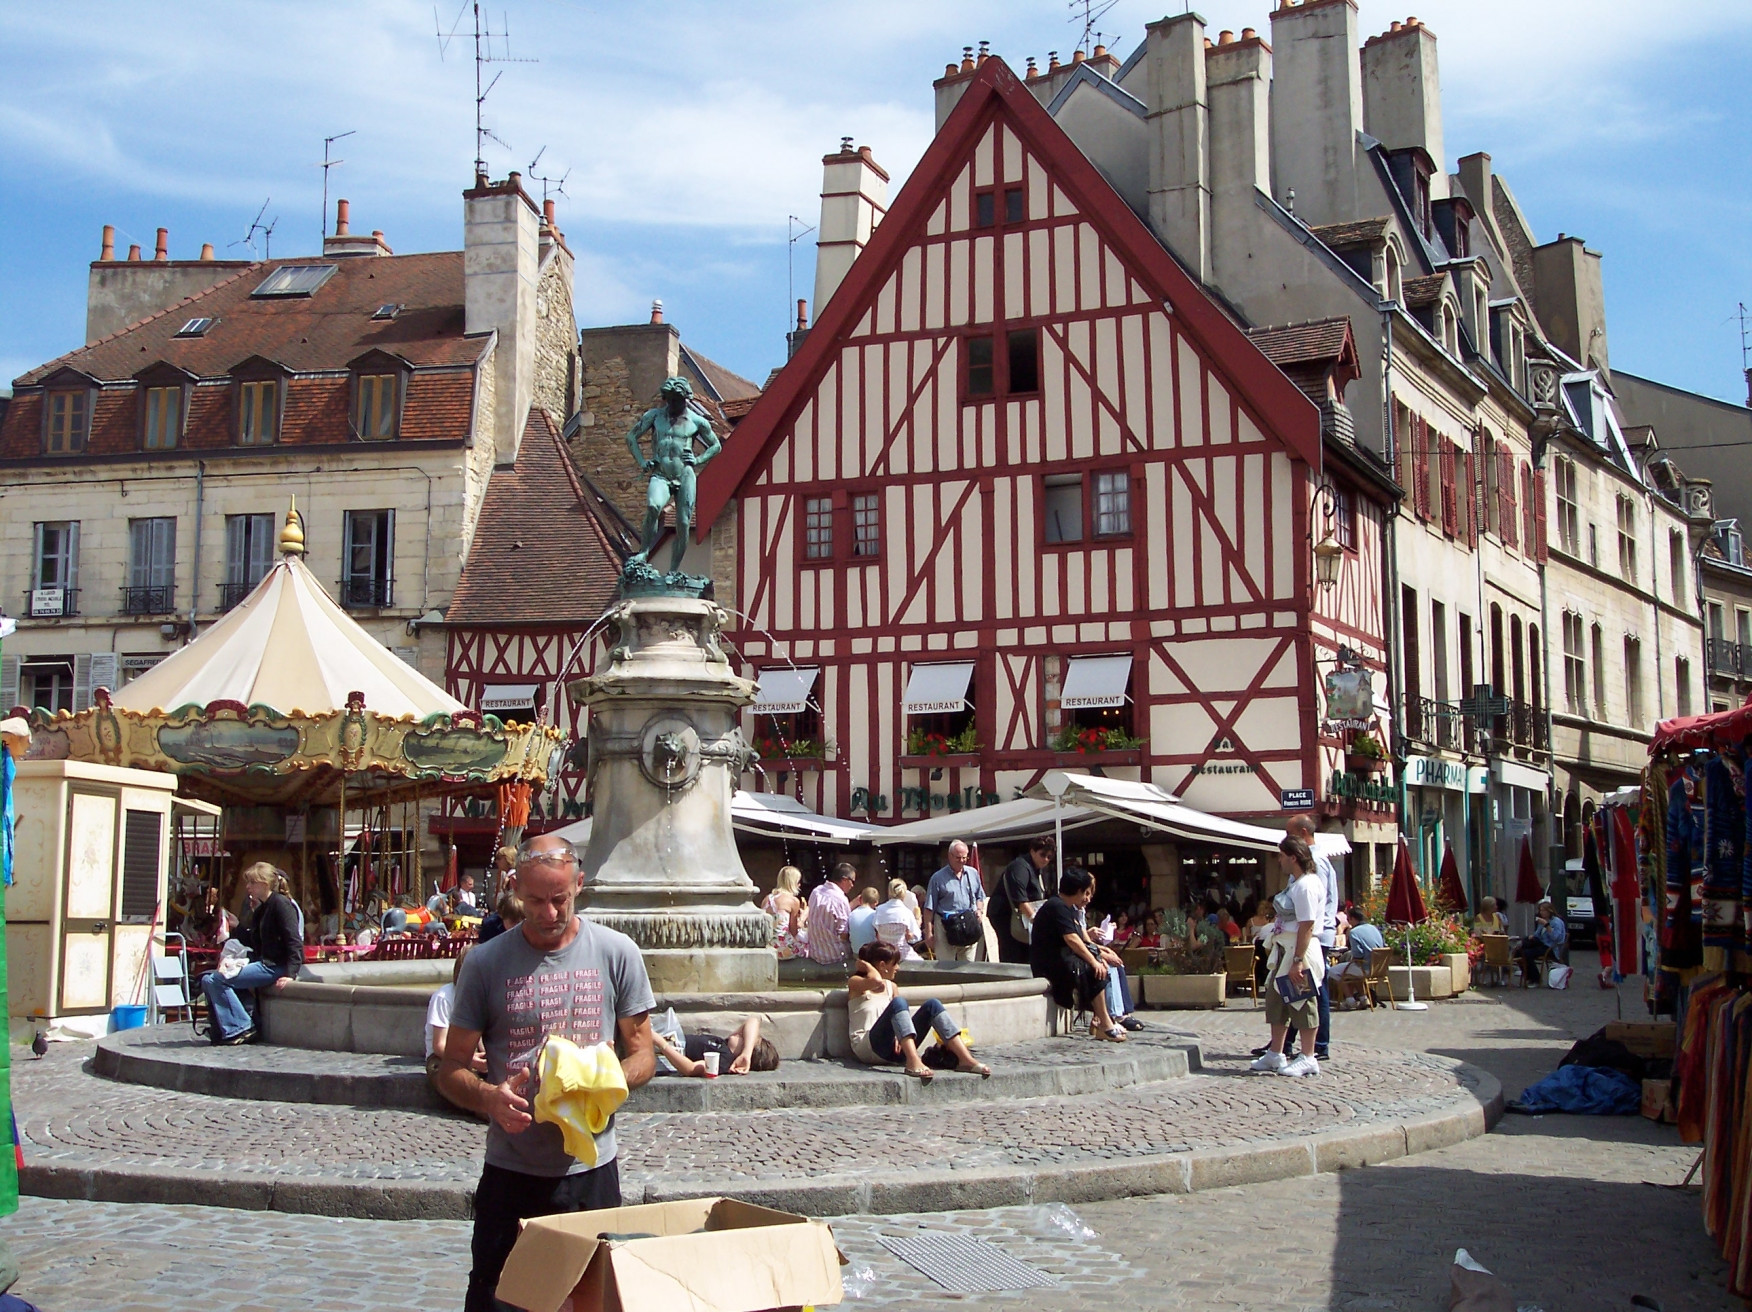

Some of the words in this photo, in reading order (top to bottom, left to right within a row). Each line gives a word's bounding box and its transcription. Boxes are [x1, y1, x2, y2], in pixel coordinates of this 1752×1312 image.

[485, 699, 530, 708] RESTAURANT
[908, 701, 960, 712] RESTAURANT
[1066, 696, 1120, 706] RESTAURANT
[752, 702, 801, 712] RESTAURANT
[1330, 718, 1371, 733] RESTAURANT
[1191, 764, 1259, 775] Restaurant
[851, 786, 888, 812] Au
[896, 785, 1000, 812] Moulin
[507, 989, 533, 999] FRAGILE
[540, 984, 568, 995] FRAGILE
[575, 981, 601, 990] FRAGILE
[575, 994, 601, 1003] FRAGILE
[541, 1008, 568, 1020] FRAGILE
[574, 1007, 601, 1016] FRAGILE
[509, 1026, 535, 1035] FRAGILE
[573, 1020, 600, 1029] FRAGILE
[509, 1039, 535, 1048] FRAGILE
